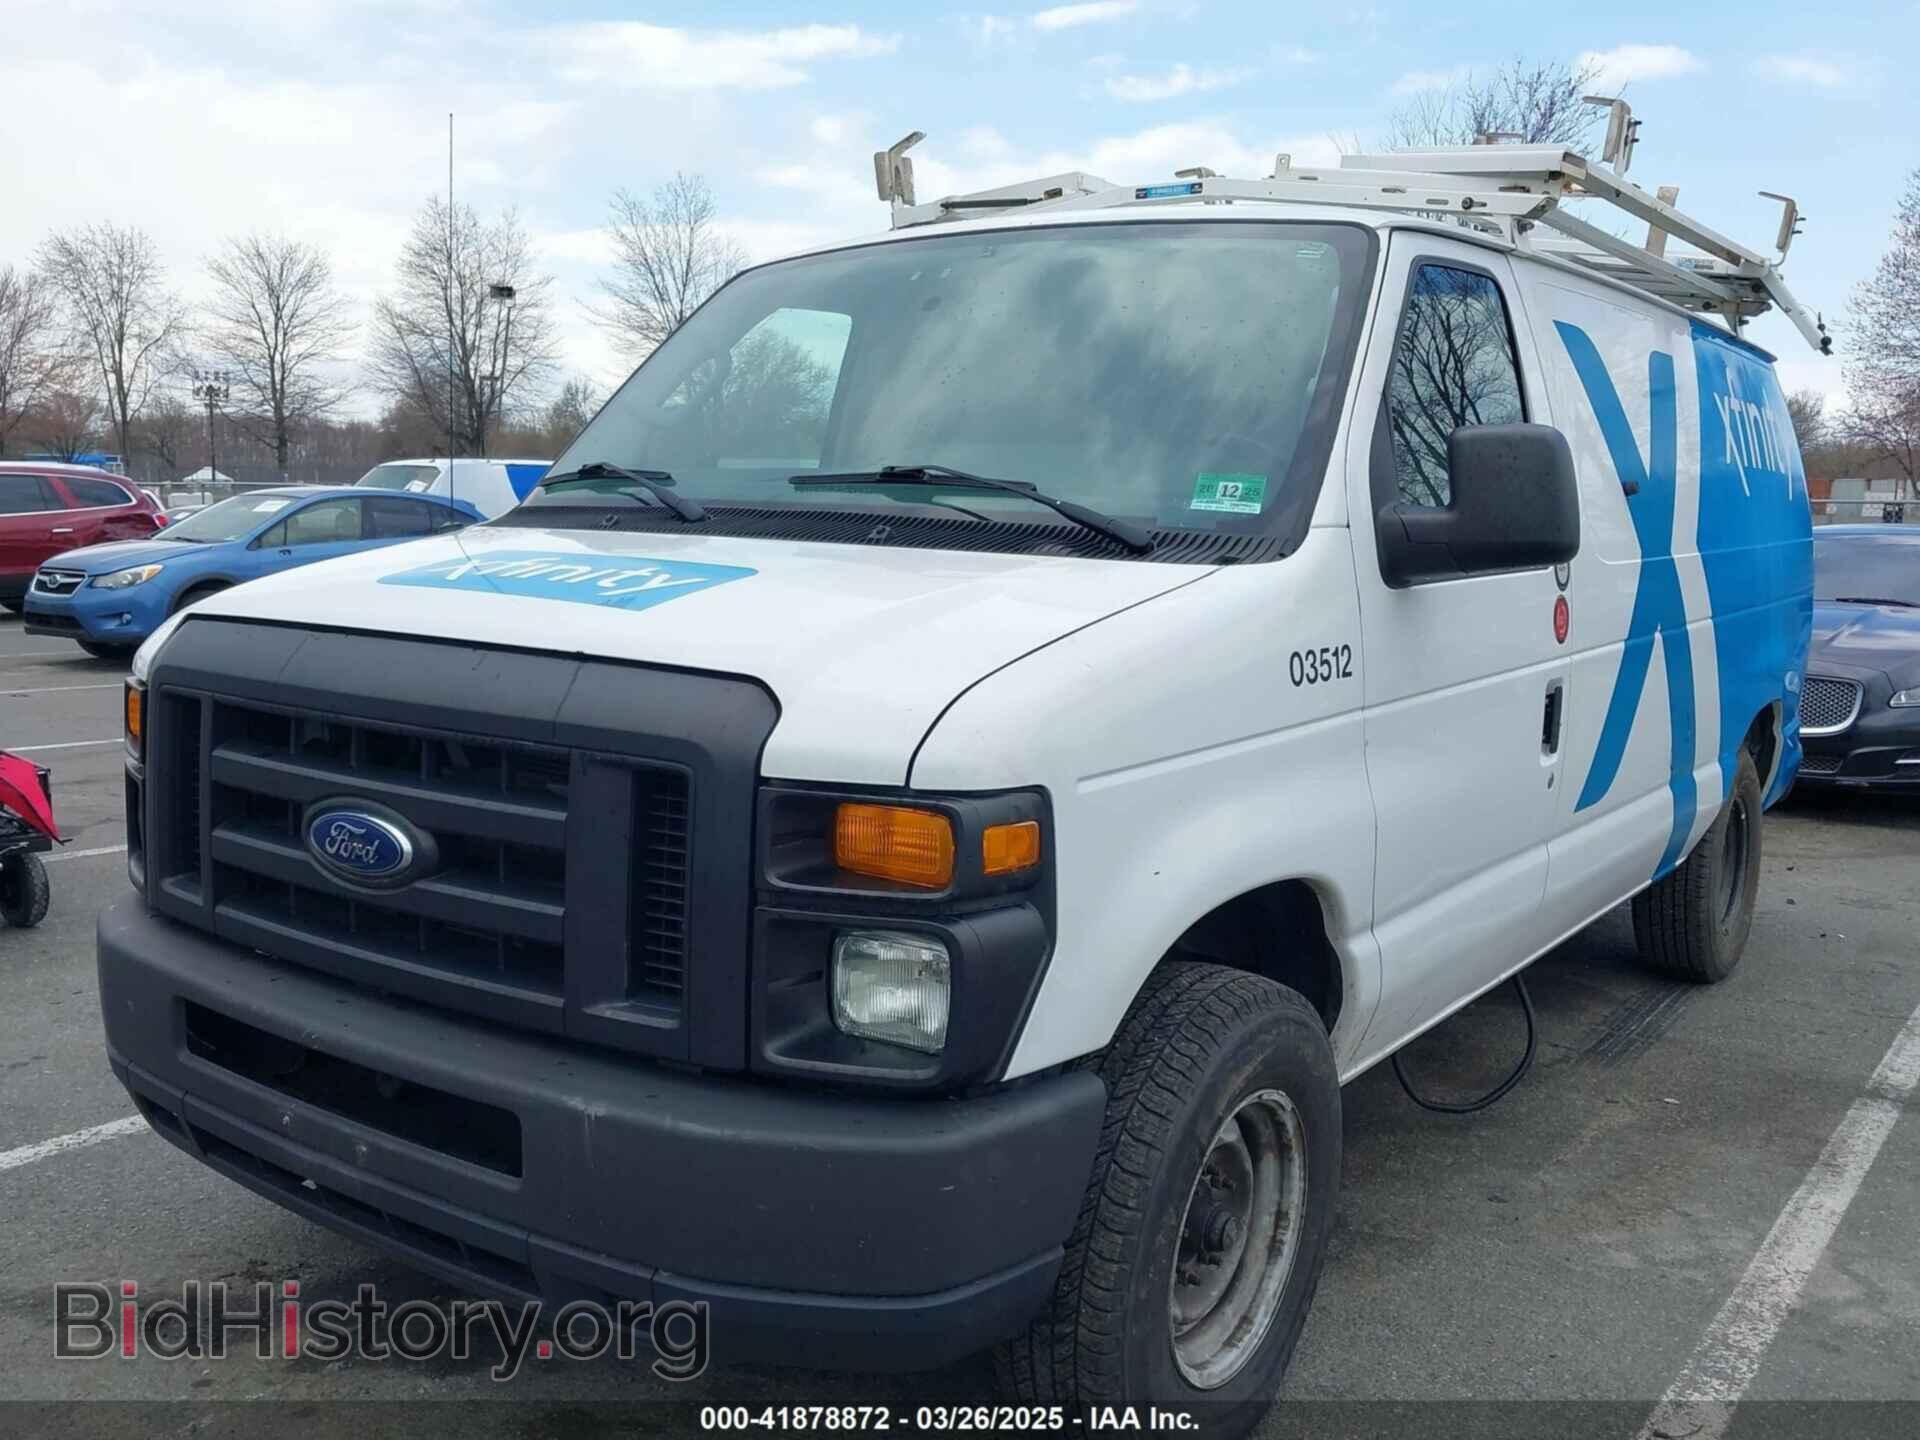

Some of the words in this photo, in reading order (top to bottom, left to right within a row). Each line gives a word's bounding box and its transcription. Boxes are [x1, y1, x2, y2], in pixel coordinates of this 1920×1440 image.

[1221, 484, 1240, 498] 12
[423, 557, 711, 597] xfinity
[1289, 643, 1353, 688] 03512
[325, 821, 381, 864] Ford
